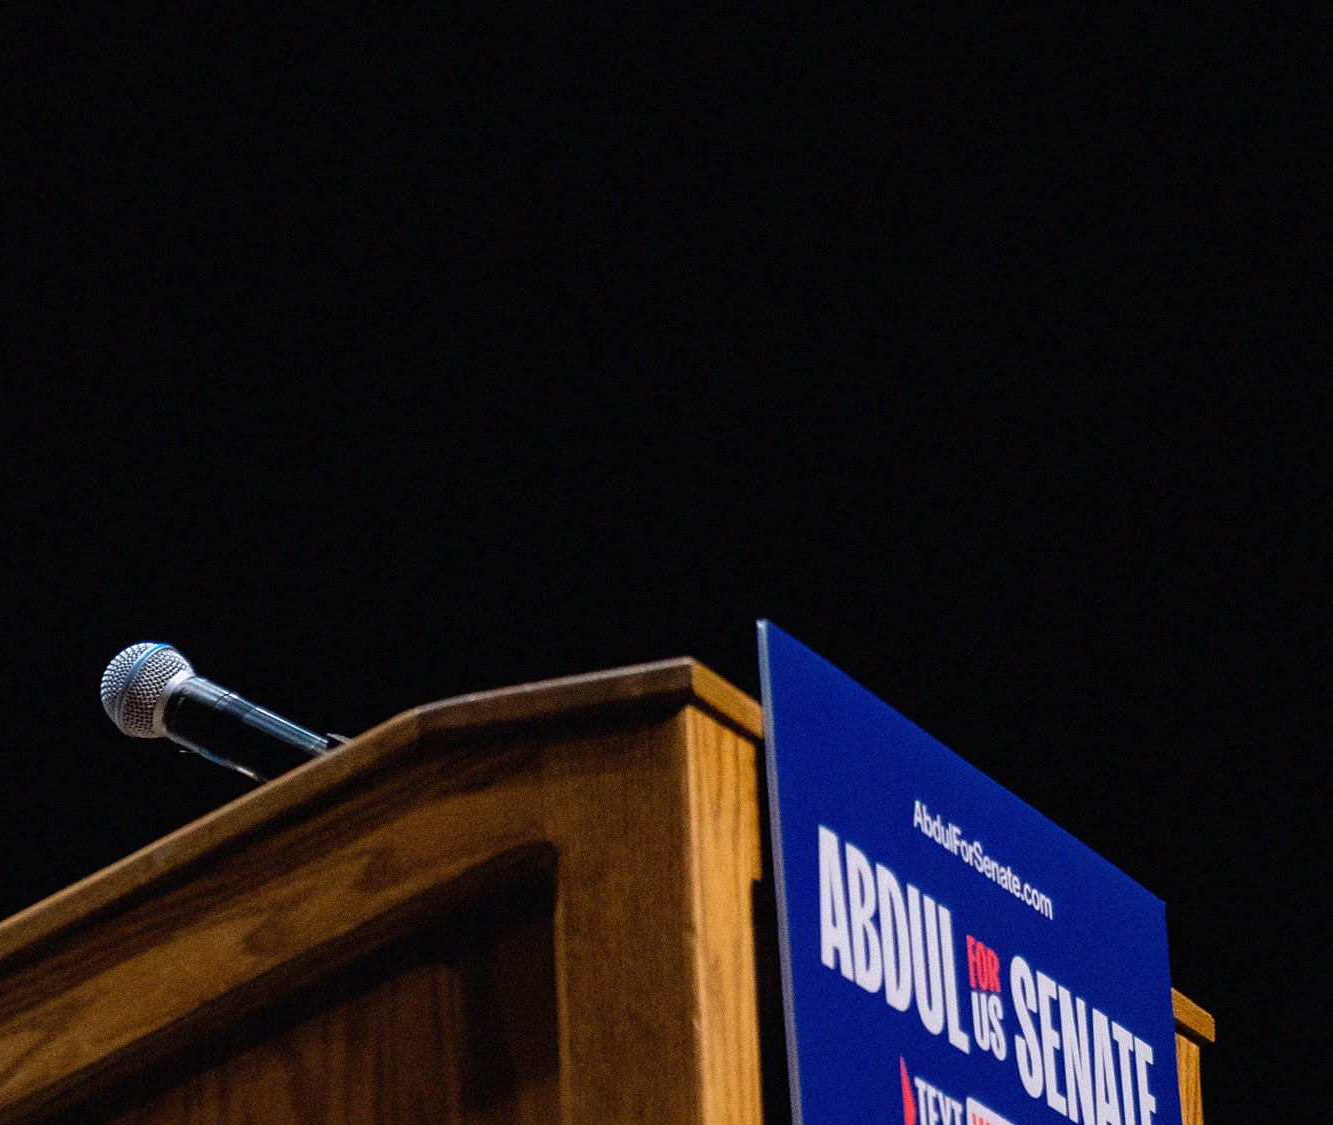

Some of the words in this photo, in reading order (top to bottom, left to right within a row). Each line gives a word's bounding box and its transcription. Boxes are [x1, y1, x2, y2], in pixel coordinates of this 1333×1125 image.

[913, 799, 1053, 921] AbdulForSenate.com
[818, 824, 970, 1055] ABDUL
[966, 934, 1001, 993] FOR
[970, 991, 1007, 1061] US
